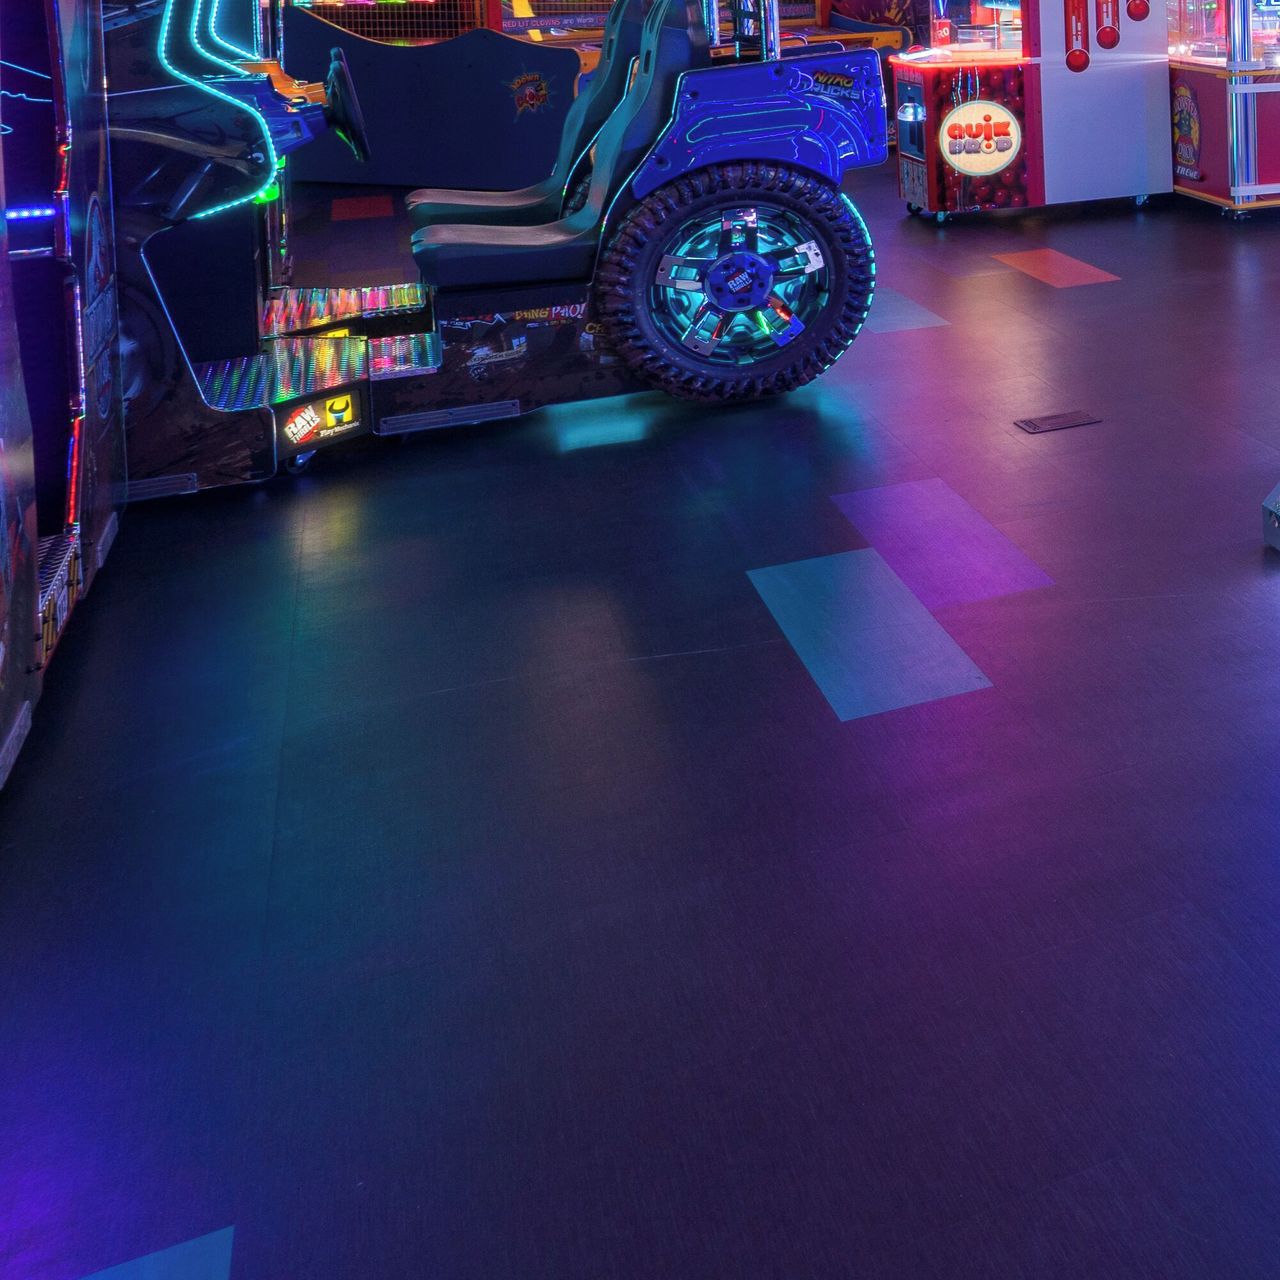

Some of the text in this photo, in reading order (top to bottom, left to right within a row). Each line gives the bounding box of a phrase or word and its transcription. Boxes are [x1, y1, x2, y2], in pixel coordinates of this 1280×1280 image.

[531, 18, 561, 27] CLOWNS
[813, 71, 855, 88] NITRO
[800, 81, 861, 101] TRUCKS
[948, 137, 1013, 155] DROP
[727, 271, 749, 290] RAW
[283, 405, 317, 437] RAW
